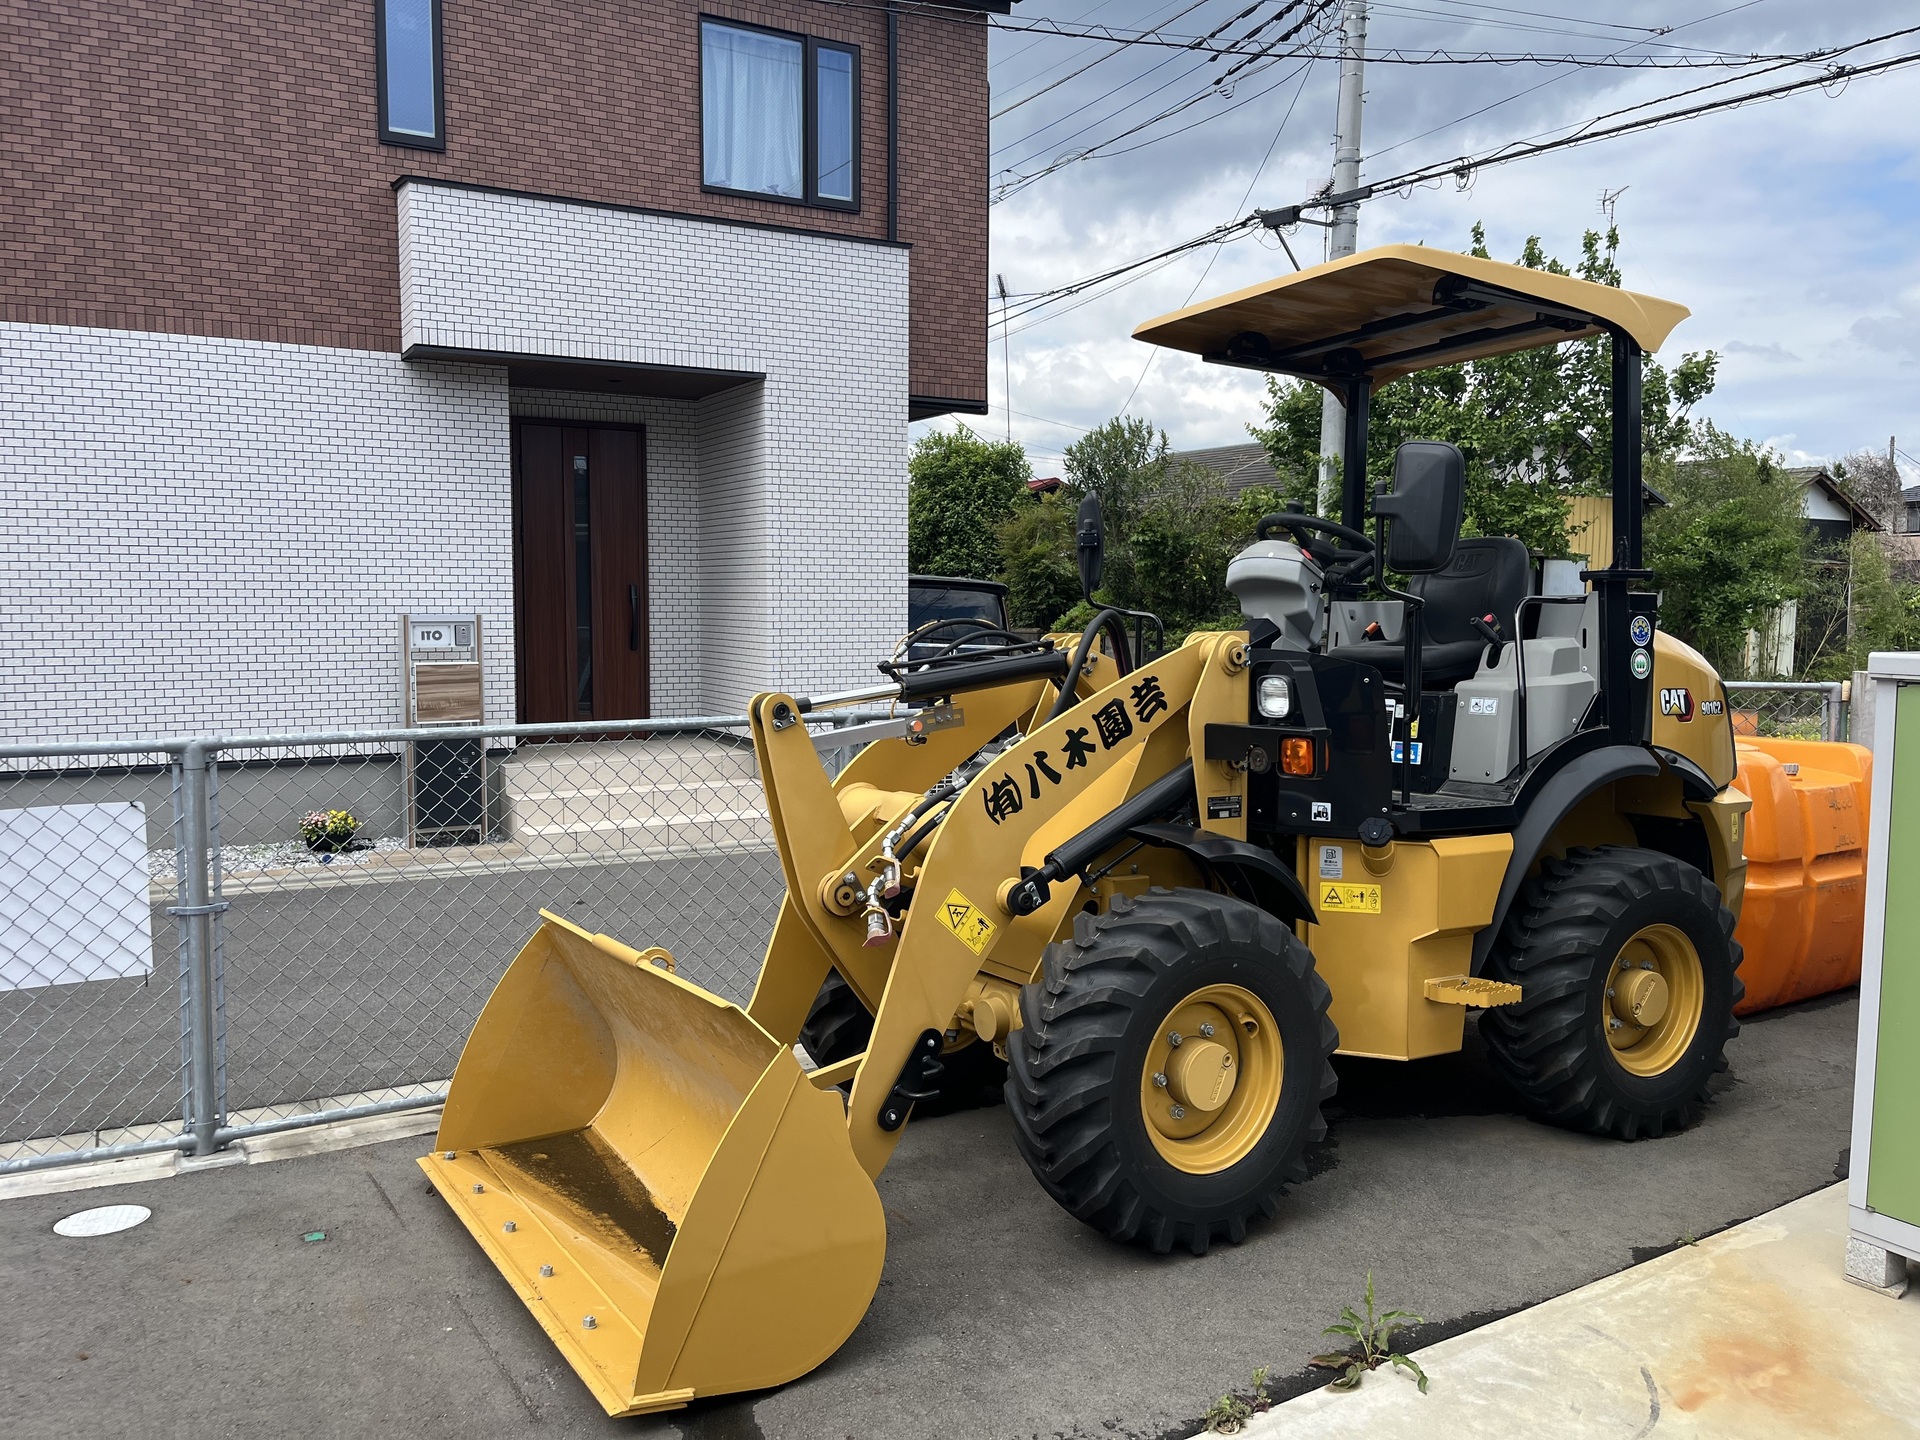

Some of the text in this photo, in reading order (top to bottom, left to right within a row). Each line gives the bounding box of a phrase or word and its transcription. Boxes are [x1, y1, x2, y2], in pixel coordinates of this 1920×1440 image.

[421, 630, 443, 641] ITO
[1660, 688, 1686, 715] CAT
[1701, 701, 1721, 715] 901C2
